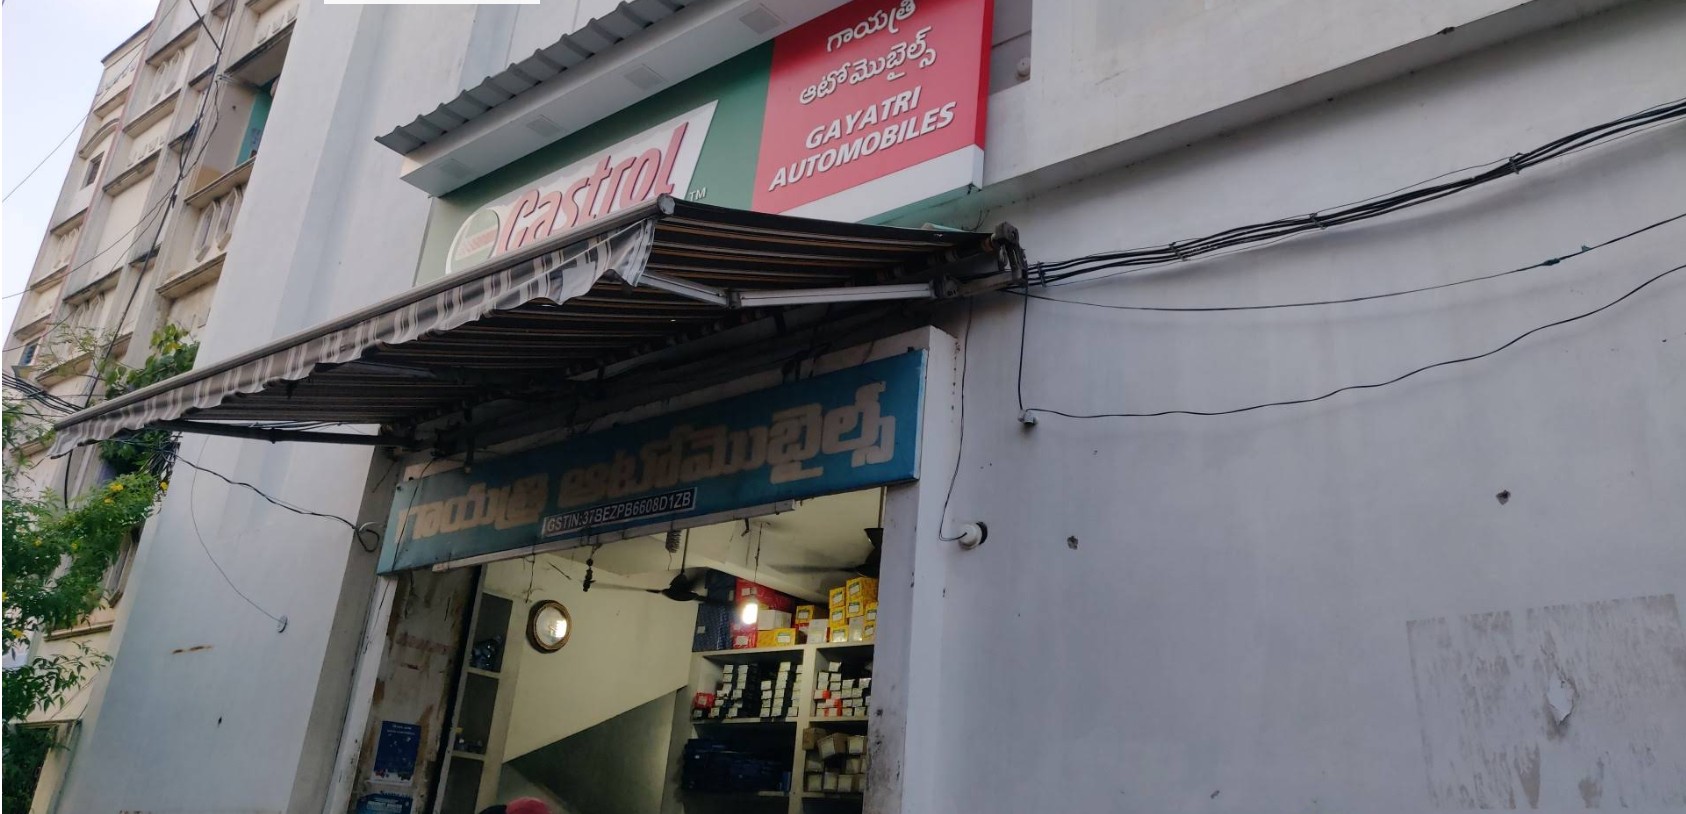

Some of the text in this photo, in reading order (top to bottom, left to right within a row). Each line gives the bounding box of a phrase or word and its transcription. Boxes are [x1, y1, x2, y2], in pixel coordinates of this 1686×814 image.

[826, 0, 917, 52] గాయత్రి
[768, 101, 956, 192] AUTOMOBILES
[805, 85, 922, 149] GAYATRI
[497, 122, 689, 254] Castrol
[546, 491, 692, 533] GSTIN:37BEZPB6608D1ZB
